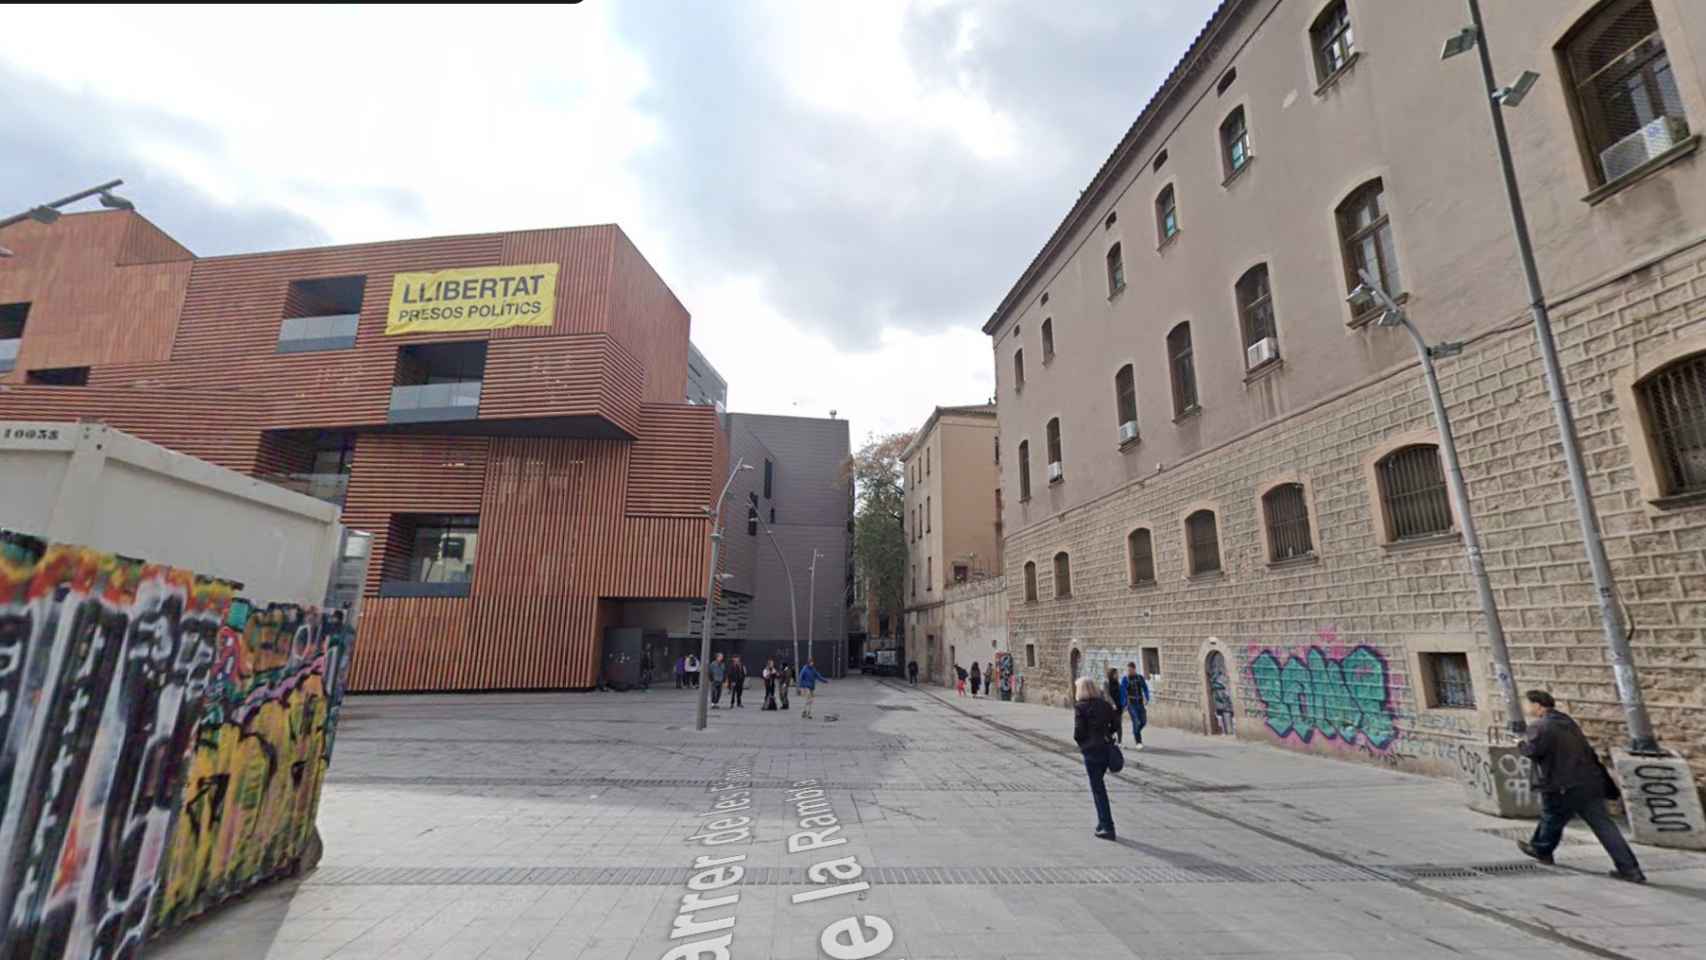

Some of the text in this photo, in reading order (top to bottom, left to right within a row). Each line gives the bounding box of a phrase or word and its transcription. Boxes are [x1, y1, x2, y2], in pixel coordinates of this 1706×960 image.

[402, 275, 545, 304] LLIBERTAT
[399, 301, 542, 322] PRESOS POLÍTICS
